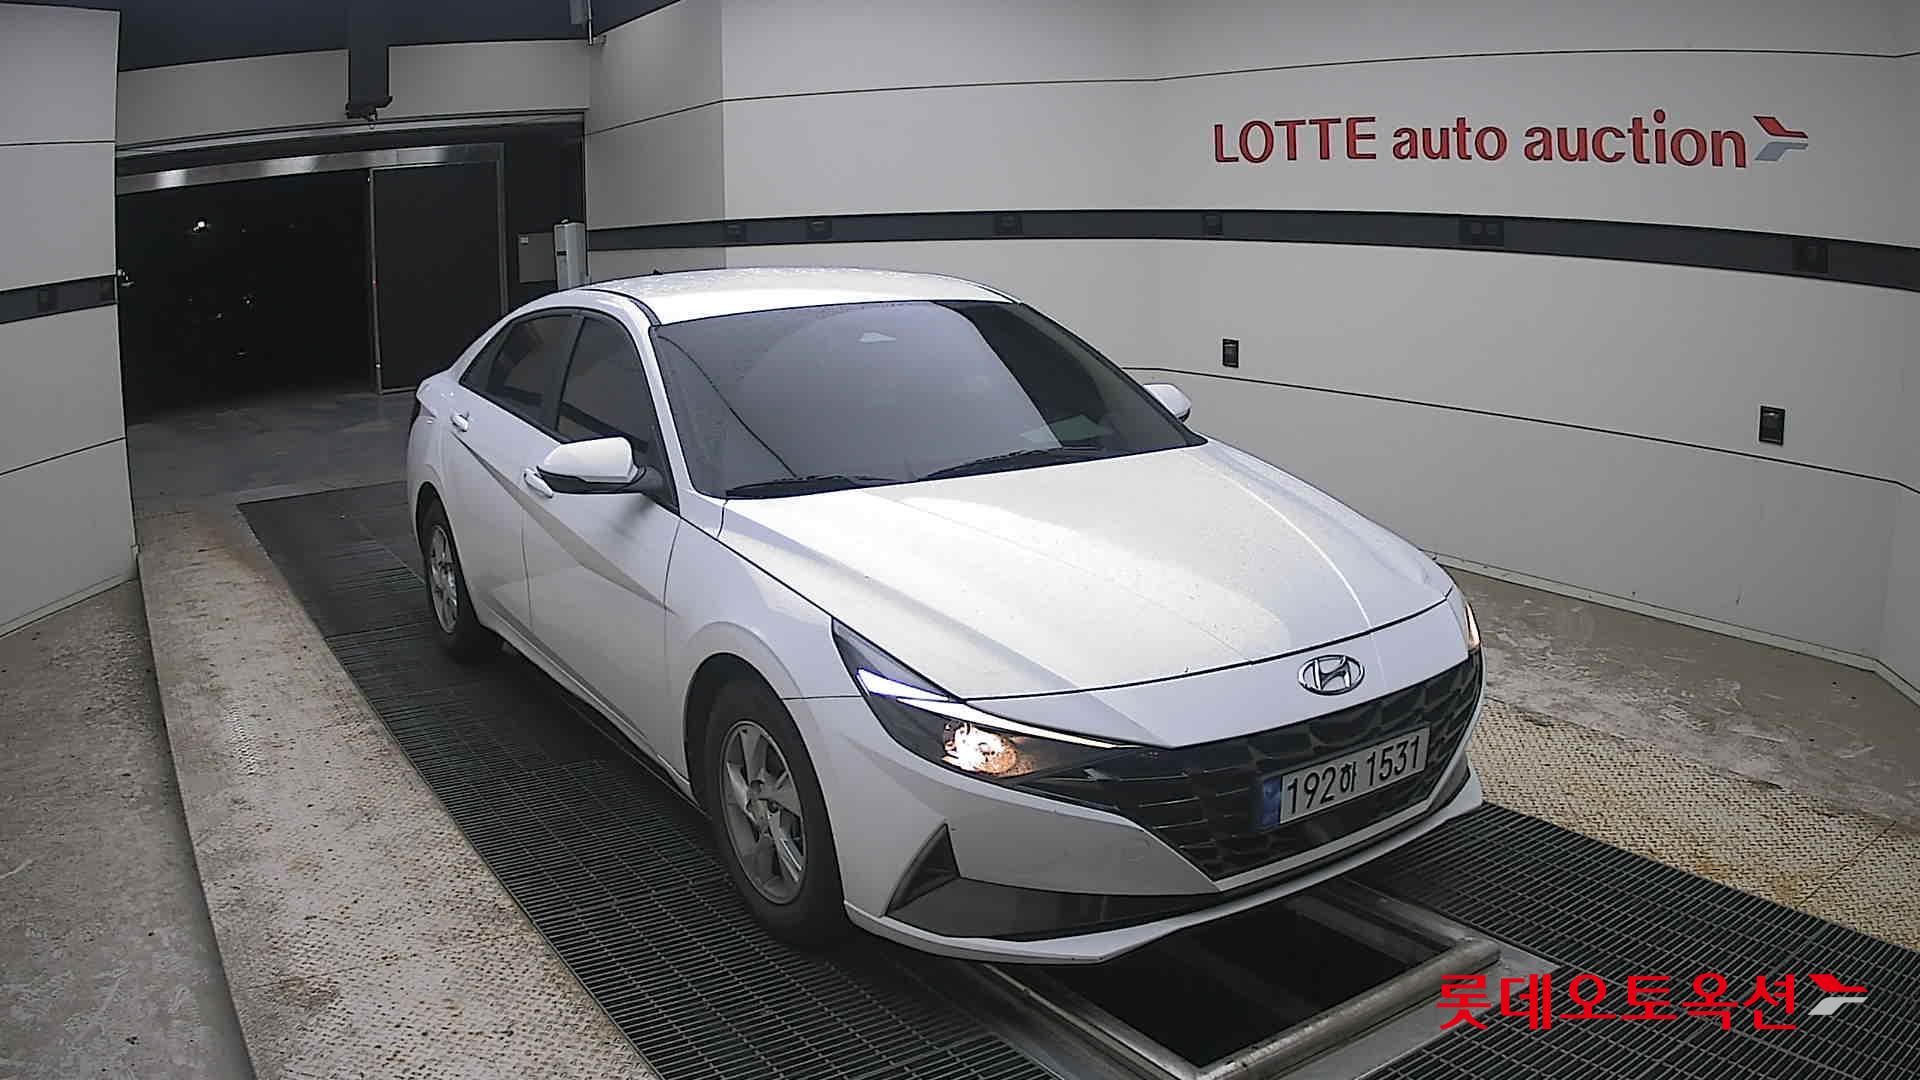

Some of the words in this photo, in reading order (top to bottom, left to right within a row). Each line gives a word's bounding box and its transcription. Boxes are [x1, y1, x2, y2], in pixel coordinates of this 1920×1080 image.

[1214, 117, 1377, 163] LOTTE
[1393, 117, 1507, 161] auto
[1524, 109, 1746, 168] auction
[1287, 761, 1357, 814] 192하
[1366, 735, 1420, 786] 1531
